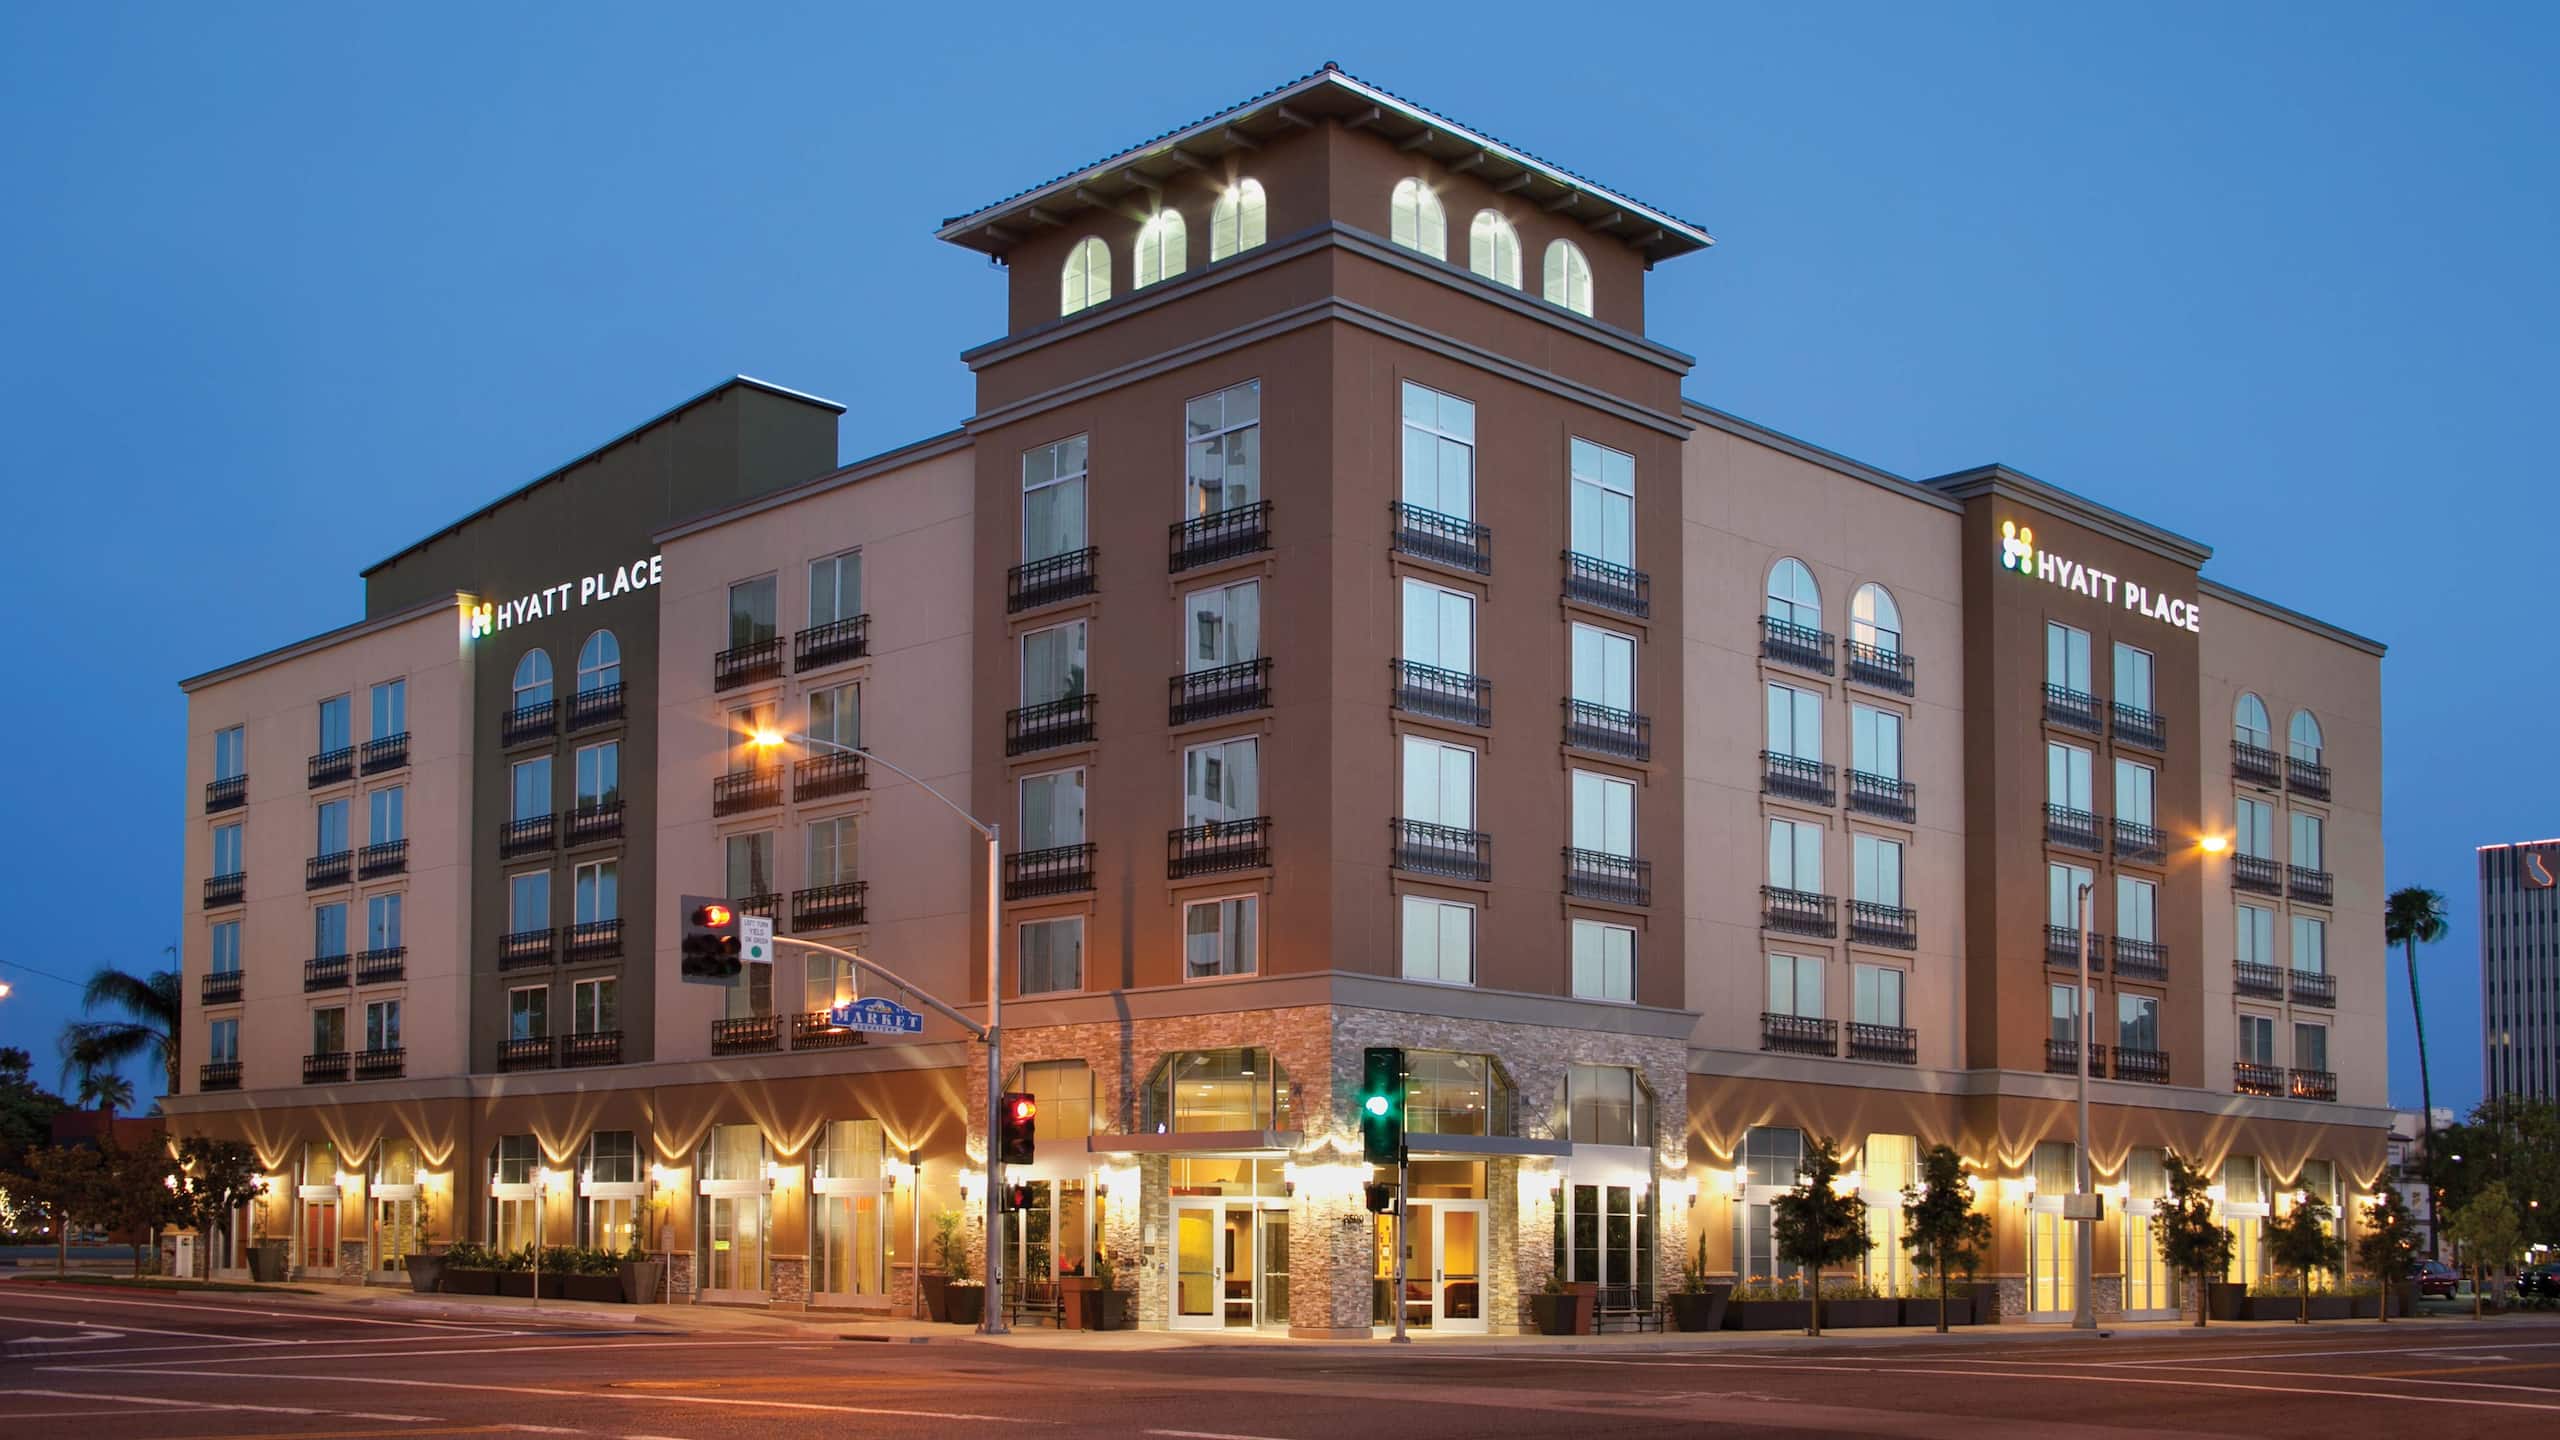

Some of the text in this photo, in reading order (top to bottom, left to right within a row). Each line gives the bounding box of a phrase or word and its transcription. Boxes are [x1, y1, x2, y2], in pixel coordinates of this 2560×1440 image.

[497, 554, 662, 631] HYATT PLACE
[2037, 550, 2200, 633] HYATT PLACE
[836, 1010, 918, 1028] MARKET
